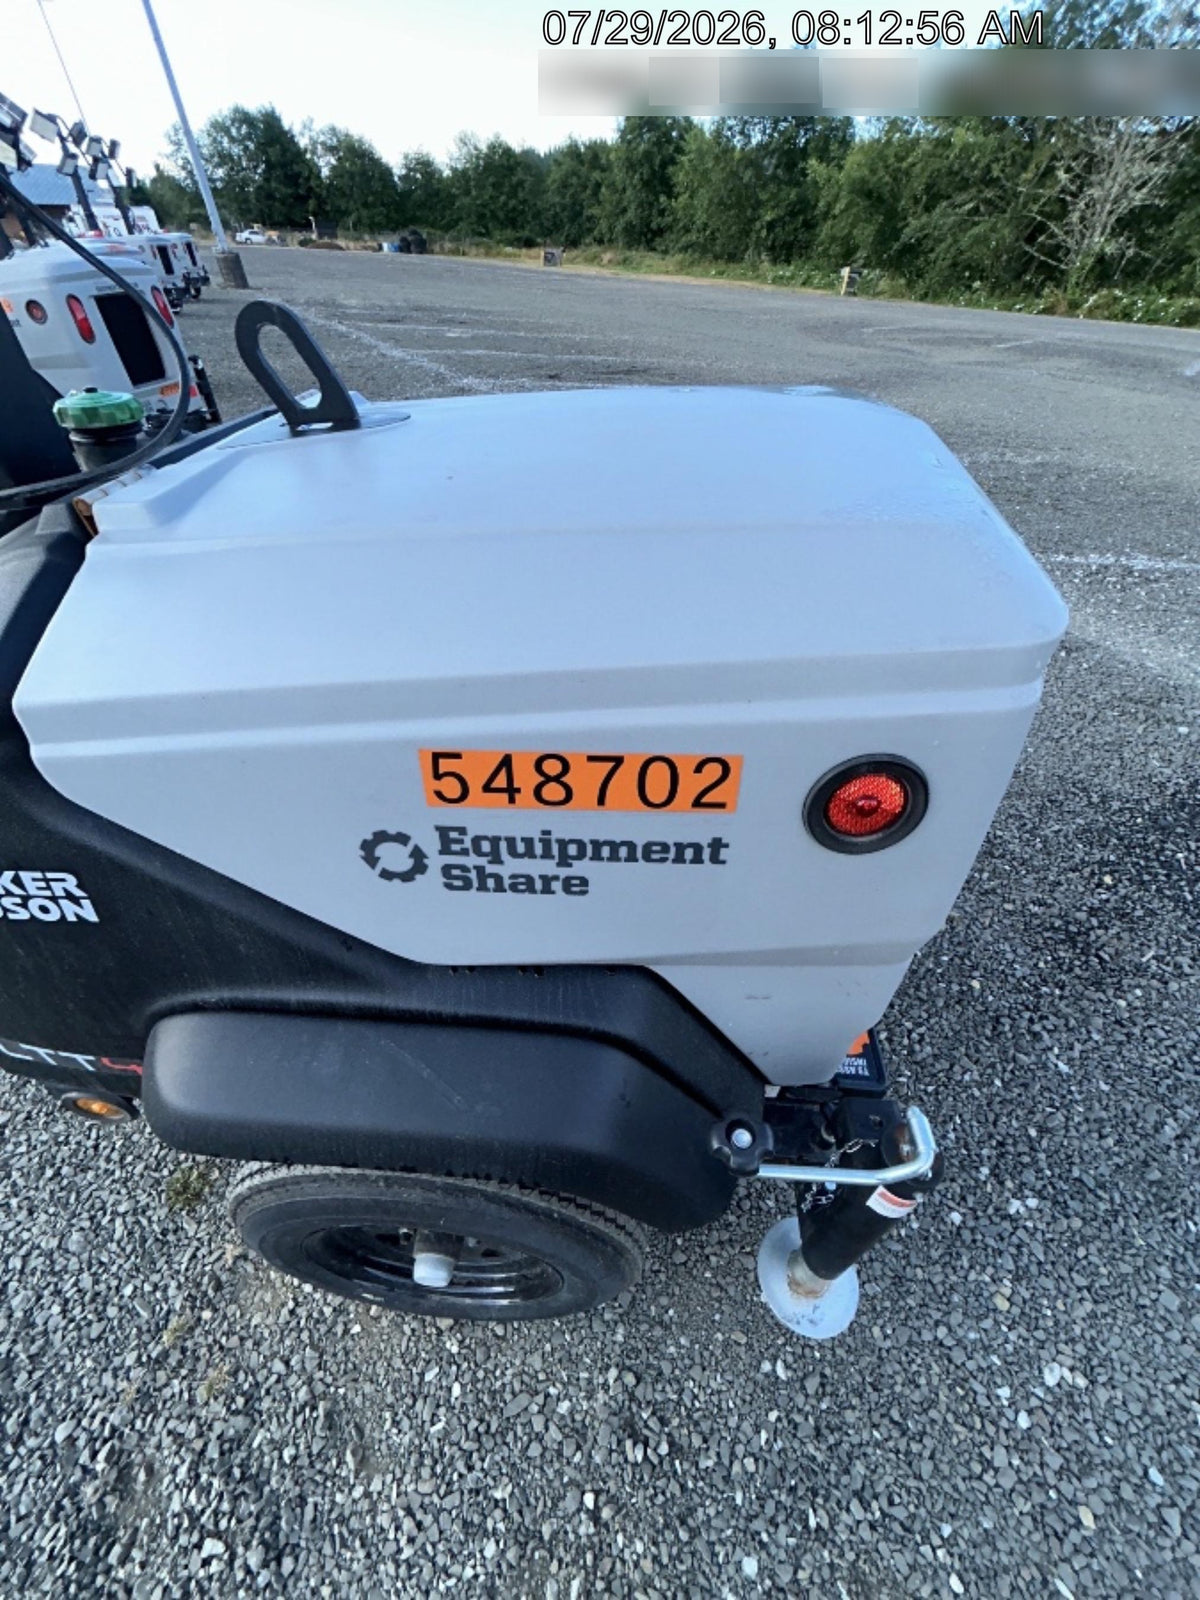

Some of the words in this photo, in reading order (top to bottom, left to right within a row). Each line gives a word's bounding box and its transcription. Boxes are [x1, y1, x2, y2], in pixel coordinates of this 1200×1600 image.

[430, 752, 732, 809] 548702
[434, 825, 730, 867] Equipment
[441, 863, 590, 896] Share
[0, 896, 100, 923] SON
